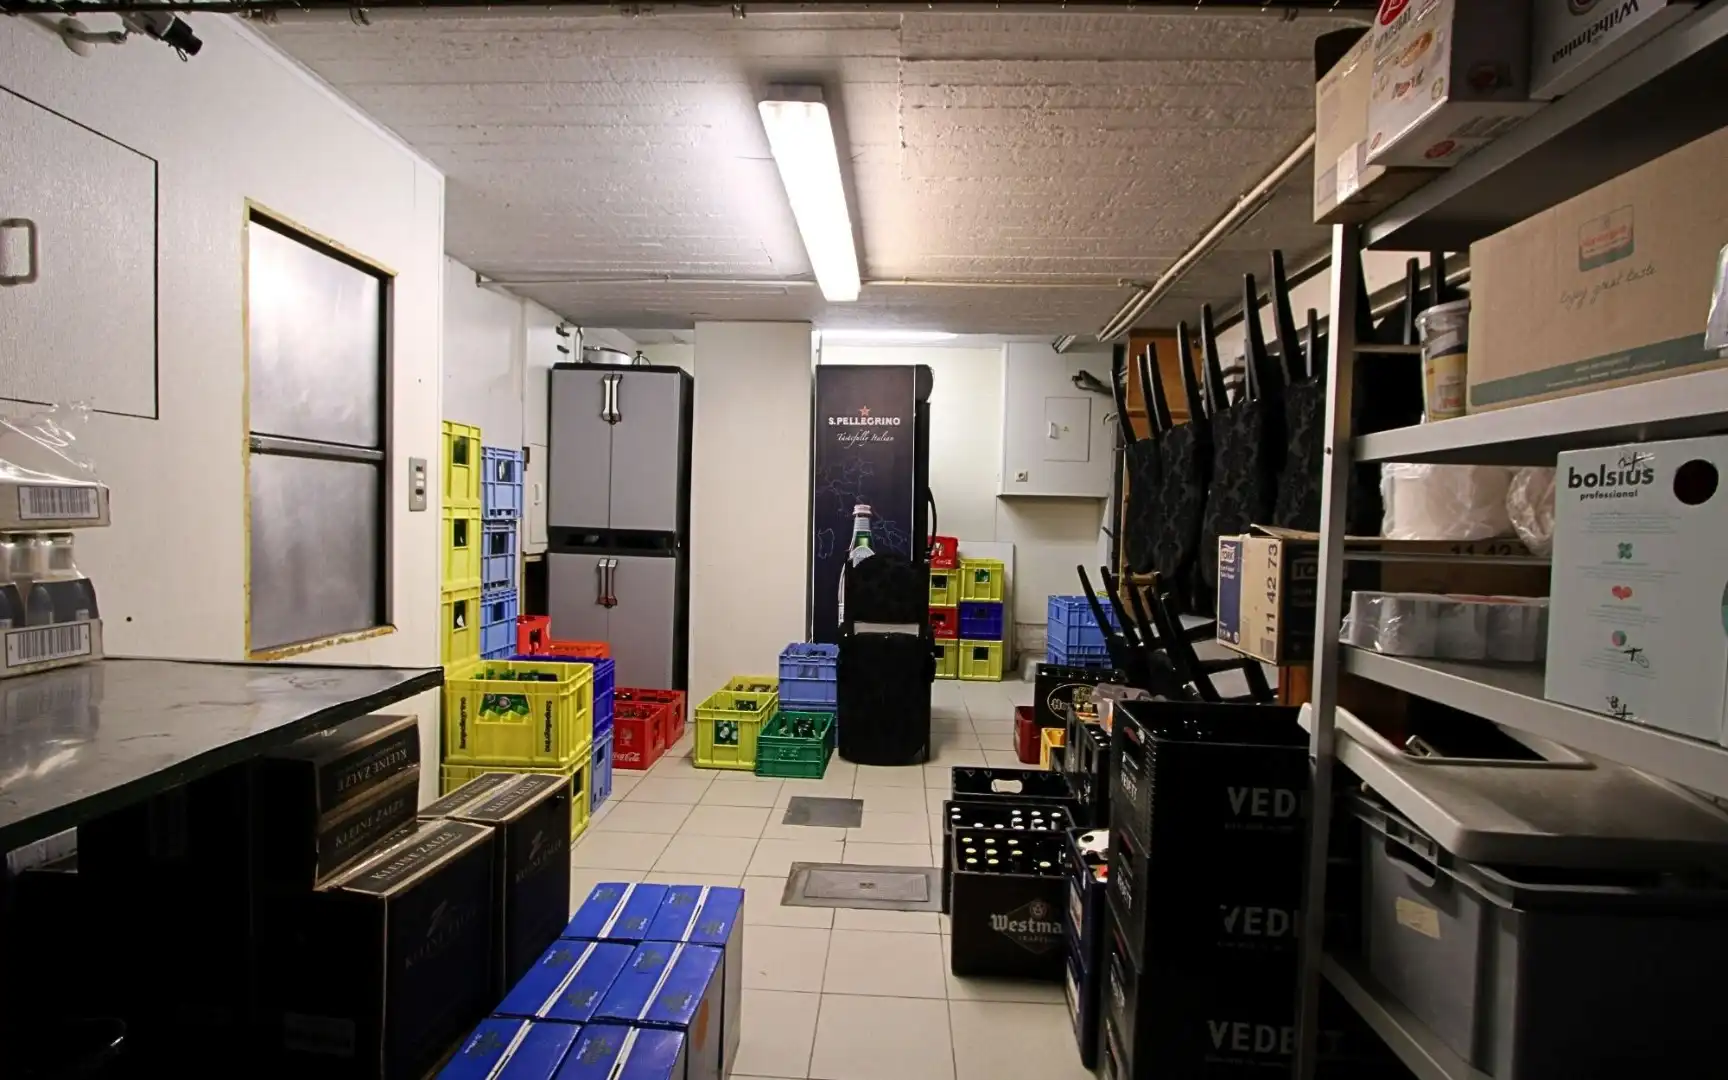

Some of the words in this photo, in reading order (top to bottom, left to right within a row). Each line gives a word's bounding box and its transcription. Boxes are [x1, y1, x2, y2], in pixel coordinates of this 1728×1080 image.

[1551, 0, 1638, 64] Wilhelmina
[828, 416, 901, 426] S.PELLEGRINO
[870, 430, 895, 442] Italian
[1568, 463, 1655, 489] bolsius
[1580, 489, 1638, 502] professional
[1268, 543, 1278, 570] 73
[1266, 577, 1277, 604] 42
[1266, 612, 1276, 635] 11
[1226, 786, 1302, 818] VED
[370, 851, 419, 880] KLEINE
[416, 831, 455, 858] ZALZE
[990, 914, 1063, 933] Westma
[1218, 904, 1302, 938] VED
